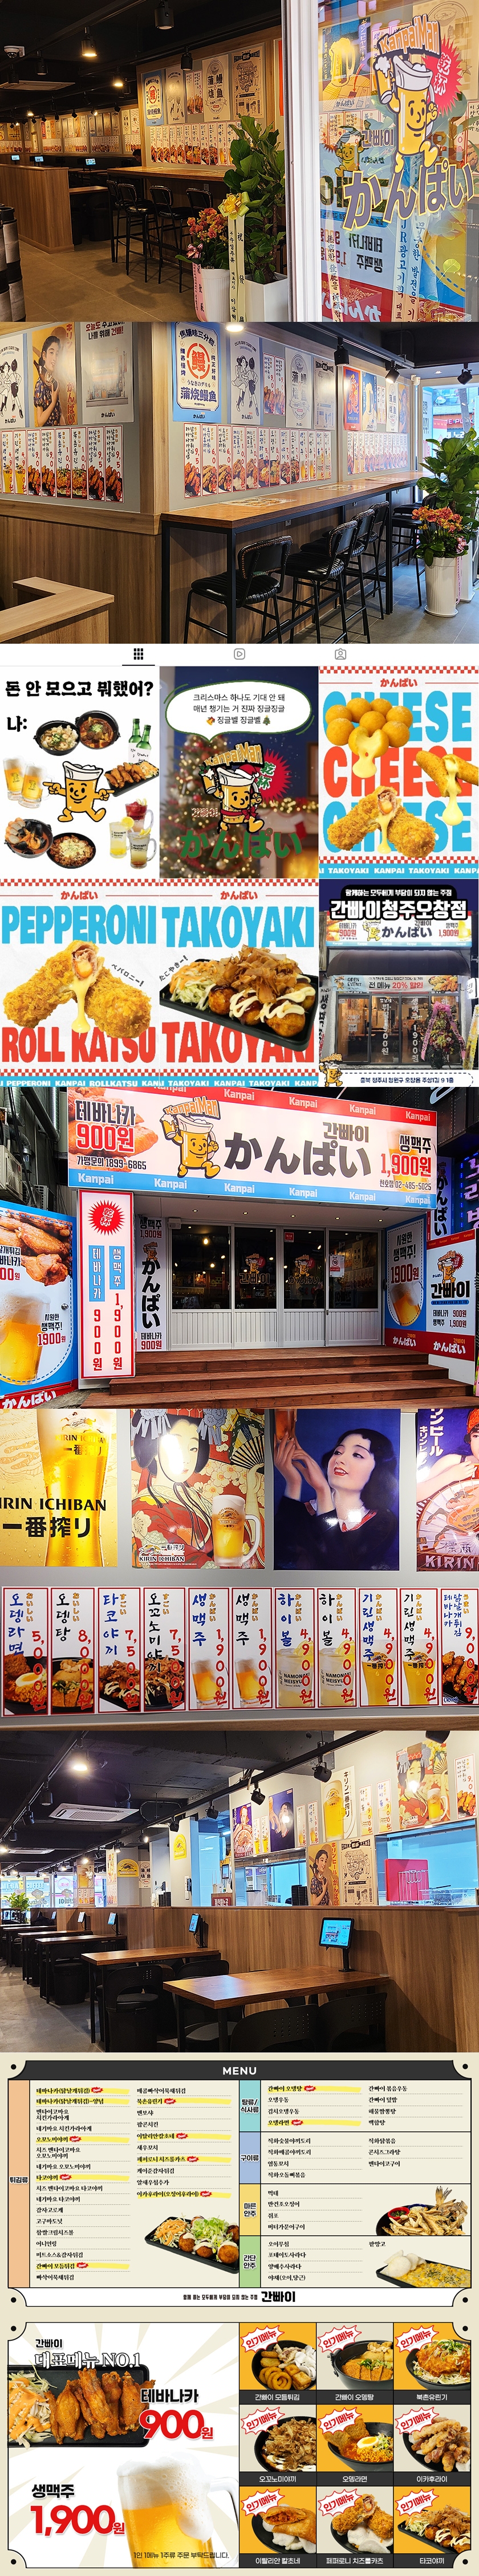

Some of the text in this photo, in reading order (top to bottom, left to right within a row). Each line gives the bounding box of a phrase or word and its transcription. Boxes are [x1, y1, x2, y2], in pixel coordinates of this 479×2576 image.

[379, 14, 440, 55] KanpaiMan
[434, 52, 452, 96] 乾杯
[362, 129, 393, 147] 간빠이
[342, 161, 474, 231] かんぱい
[88, 332, 98, 340] 나를
[111, 327, 124, 336] 건배!
[380, 678, 417, 688] かんぱい
[180, 828, 302, 860] かんぱい
[61, 891, 98, 900] かんぱい
[220, 891, 258, 900] かんぱい
[2, 905, 156, 944] PEPPERONI
[162, 905, 314, 948] TAKOYAKI
[381, 926, 432, 938] かんぱい
[2, 1027, 65, 1062] ROLL
[75, 1099, 135, 1126] 테바나카
[165, 1098, 220, 1119] KanpaiMan
[289, 1097, 317, 1109] Kanpai
[77, 1125, 135, 1152] 900원
[323, 1122, 369, 1143] 간빠이
[399, 1134, 432, 1154] 생맥주
[77, 1155, 147, 1170] 가맹문의 1899-6865
[224, 1131, 371, 1178] かんぱい
[381, 1153, 432, 1178] 1,900원
[78, 1173, 430, 1205] Kanpai Kanpai
[380, 1179, 432, 1191] 천호점 02-485-5025
[100, 1207, 114, 1226] 乾杯
[434, 1176, 448, 1236] かんぱい
[141, 1258, 161, 1329] かんぱい
[431, 1280, 470, 1299] 간빠이
[113, 1248, 124, 1371] 생맥주 1,900원
[433, 1309, 466, 1318] 테바나카 900원
[41, 1322, 62, 1331] 생맥주!
[38, 1332, 66, 1347] 1900원
[93, 1309, 103, 1371] 900원
[433, 1342, 466, 1354] かんぱい
[40, 1498, 107, 1511] ICHIBAN
[2, 1516, 91, 1538] 一番搾り
[425, 1555, 474, 1569] KIRIN
[8, 1592, 25, 1656] 오뎅라면
[55, 1593, 71, 1642] 오뎅탕
[103, 1592, 119, 1655] 타코야끼
[192, 1592, 207, 1647] 생맥주
[277, 1593, 294, 1647] 하이볼
[363, 1593, 375, 1661] 기린생맥주
[147, 1592, 161, 1673] 오꼬노미야끼
[30, 1630, 46, 1711] 5,000원
[77, 1629, 93, 1711] 8,000원
[213, 1628, 228, 1706] 1,900원
[261, 2291, 295, 2302] 간빠이
[35, 2339, 63, 2348] 간빠이
[246, 2329, 277, 2348] 인기메뉴
[35, 2352, 140, 2369] 대표메뉴 NO.1
[140, 2389, 198, 2404] 테바나카
[139, 2409, 214, 2439] 900원
[31, 2484, 75, 2499] 생맥주
[30, 2505, 125, 2536] 1,900원
